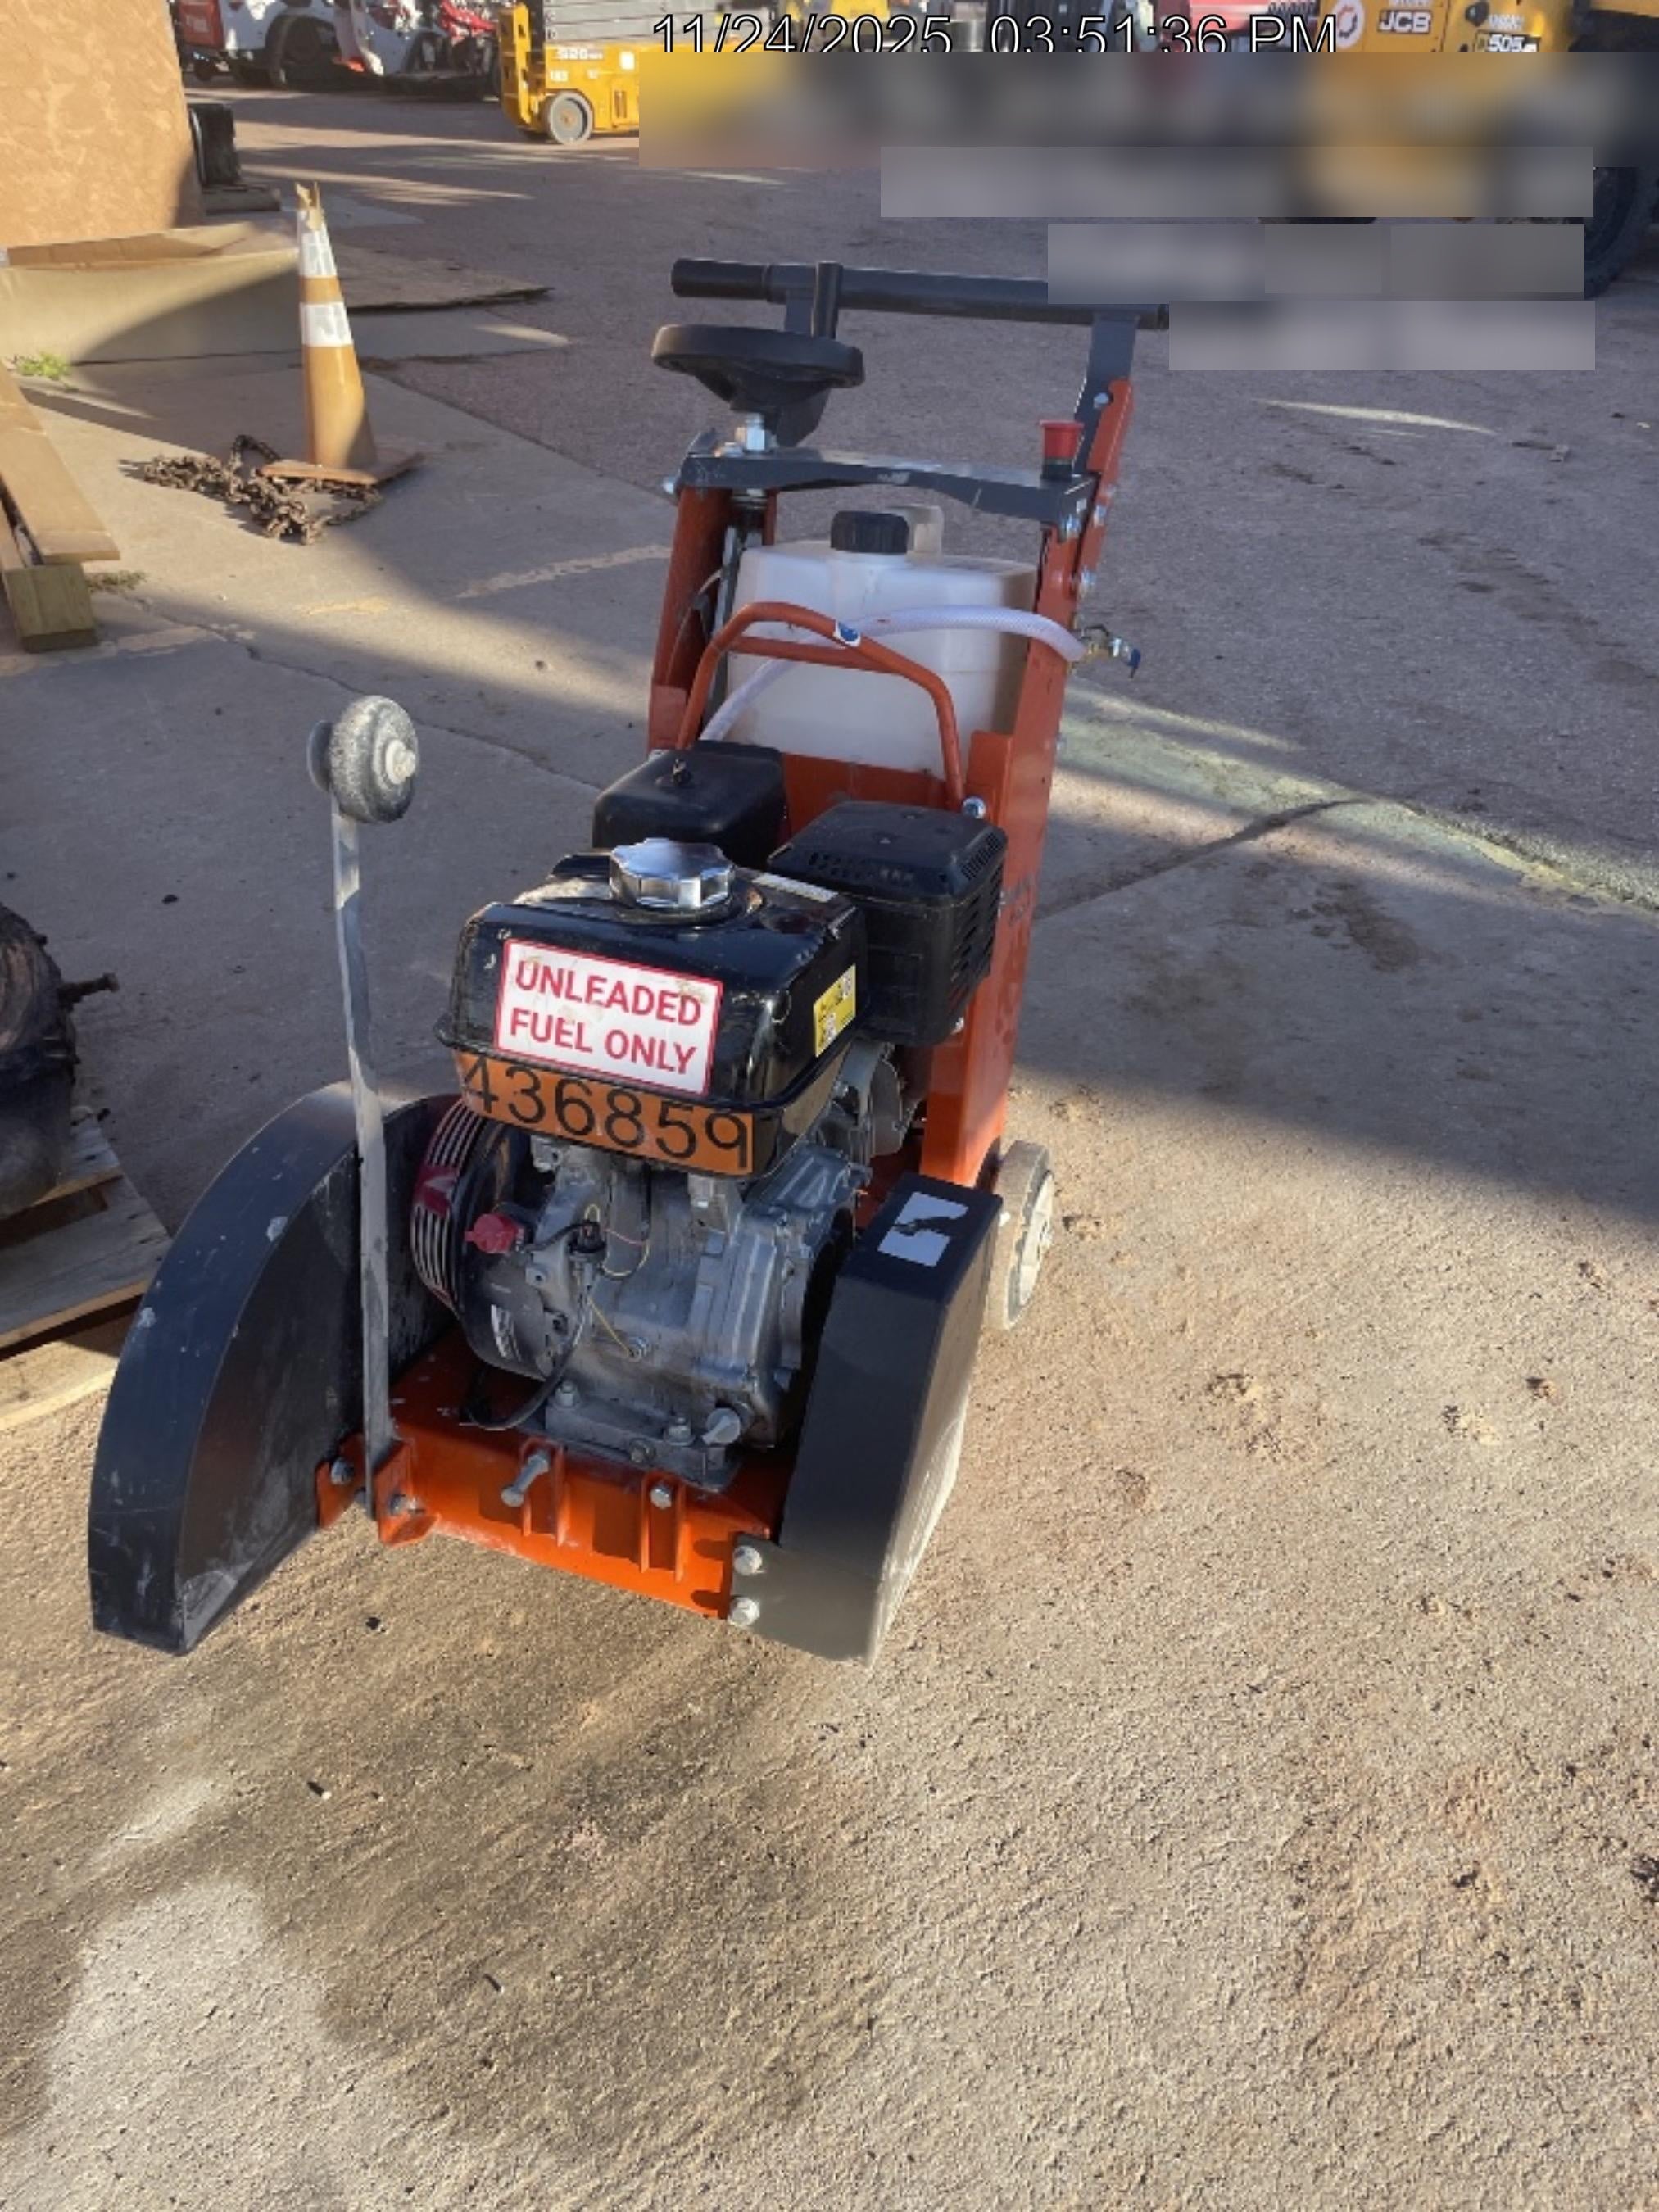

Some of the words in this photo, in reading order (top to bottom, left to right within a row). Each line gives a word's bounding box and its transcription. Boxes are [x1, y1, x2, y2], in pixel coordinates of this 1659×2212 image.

[1379, 11, 1430, 33] JCB
[514, 959, 703, 1027] UNLEADED
[509, 1007, 593, 1054] FUEL
[603, 1028, 697, 1076] ONLY
[462, 1054, 750, 1170] 436859
